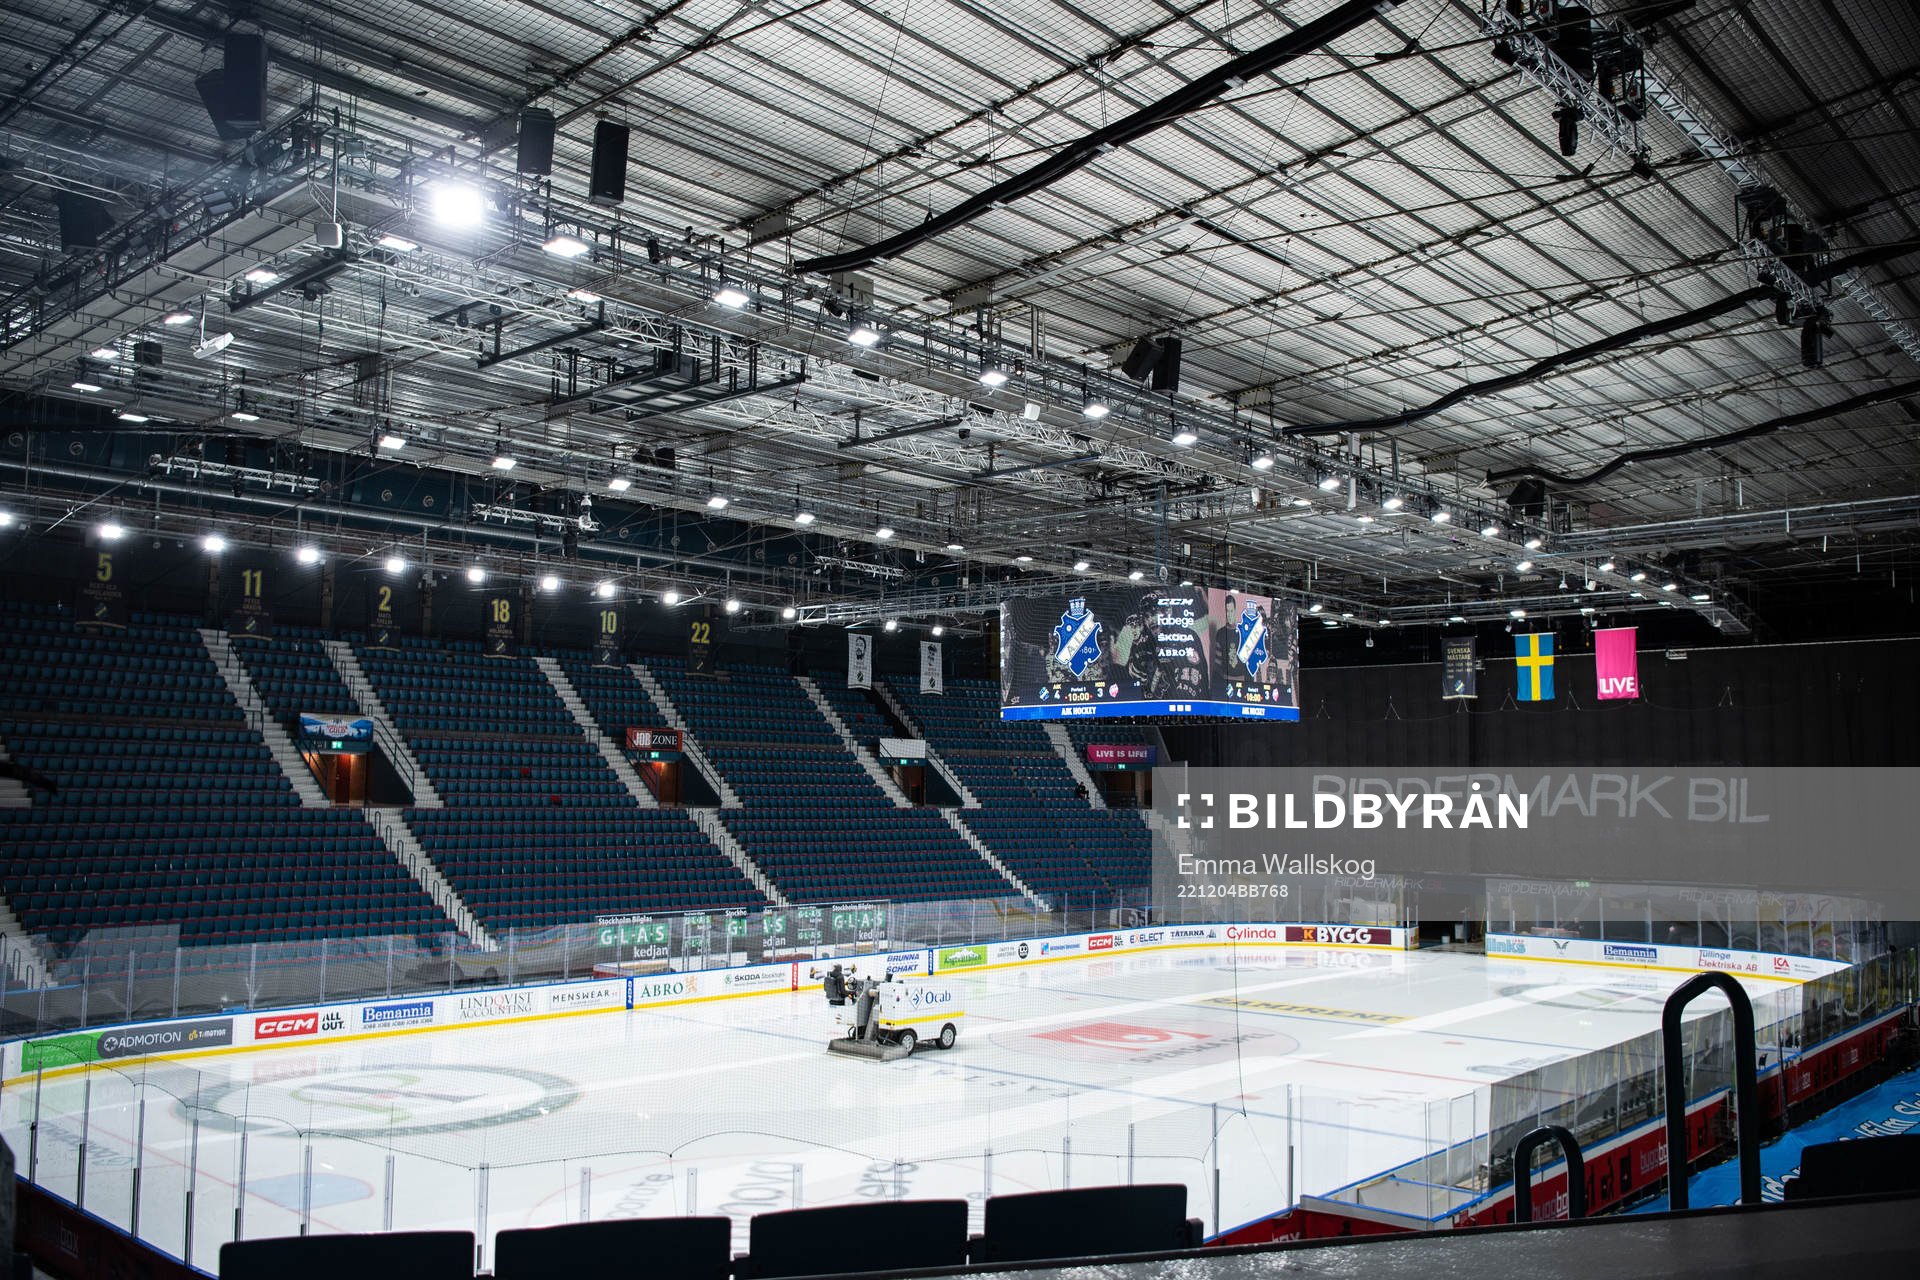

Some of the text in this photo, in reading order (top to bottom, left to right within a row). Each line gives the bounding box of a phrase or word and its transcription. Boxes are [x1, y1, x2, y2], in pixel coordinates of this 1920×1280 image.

[96, 552, 112, 582] 5
[242, 569, 262, 598] 11
[378, 585, 392, 612] 2
[1157, 598, 1194, 606] CCM
[491, 598, 510, 623] 18
[600, 610, 617, 634] 10
[1157, 614, 1194, 628] Fabege
[691, 621, 711, 644] 22
[1599, 676, 1636, 694] LIVE
[1054, 690, 1060, 699] 4
[1068, 692, 1090, 702] 10:00
[1097, 688, 1103, 697] 3
[1264, 690, 1270, 700] 3
[1073, 706, 1097, 715] HOCKEY
[633, 731, 678, 746] JOB ZONE
[1096, 750, 1114, 758] LIVE
[1117, 750, 1125, 758] IS
[1687, 776, 1771, 823] BIL
[1334, 876, 1424, 889] RIDDERMARK
[1498, 883, 1590, 897] RIDDERMARK
[1678, 890, 1784, 907] RIDDERMARK
[598, 915, 653, 926] Stockholm Bilglas
[1226, 927, 1277, 940] Cylinda
[1316, 927, 1372, 944] BYGG
[1089, 938, 1112, 948] CCM
[634, 945, 668, 959] kedjan
[887, 953, 919, 962] BRUNNA
[1606, 945, 1656, 958] Bemannia
[886, 964, 918, 973] SCHAKT
[1745, 963, 1758, 972] AB
[1774, 957, 1790, 968] ICA
[734, 974, 760, 982] ŠKODA
[459, 991, 534, 1010] LINDQVIST
[552, 989, 610, 1003] MENSWEAR
[925, 990, 951, 1004] Ocab
[322, 1012, 341, 1022] ALL
[365, 1003, 431, 1021] Bemannia
[459, 1003, 532, 1019] ACCOUNTING
[258, 1017, 316, 1034] CCM
[118, 1031, 182, 1049] ADMOTION
